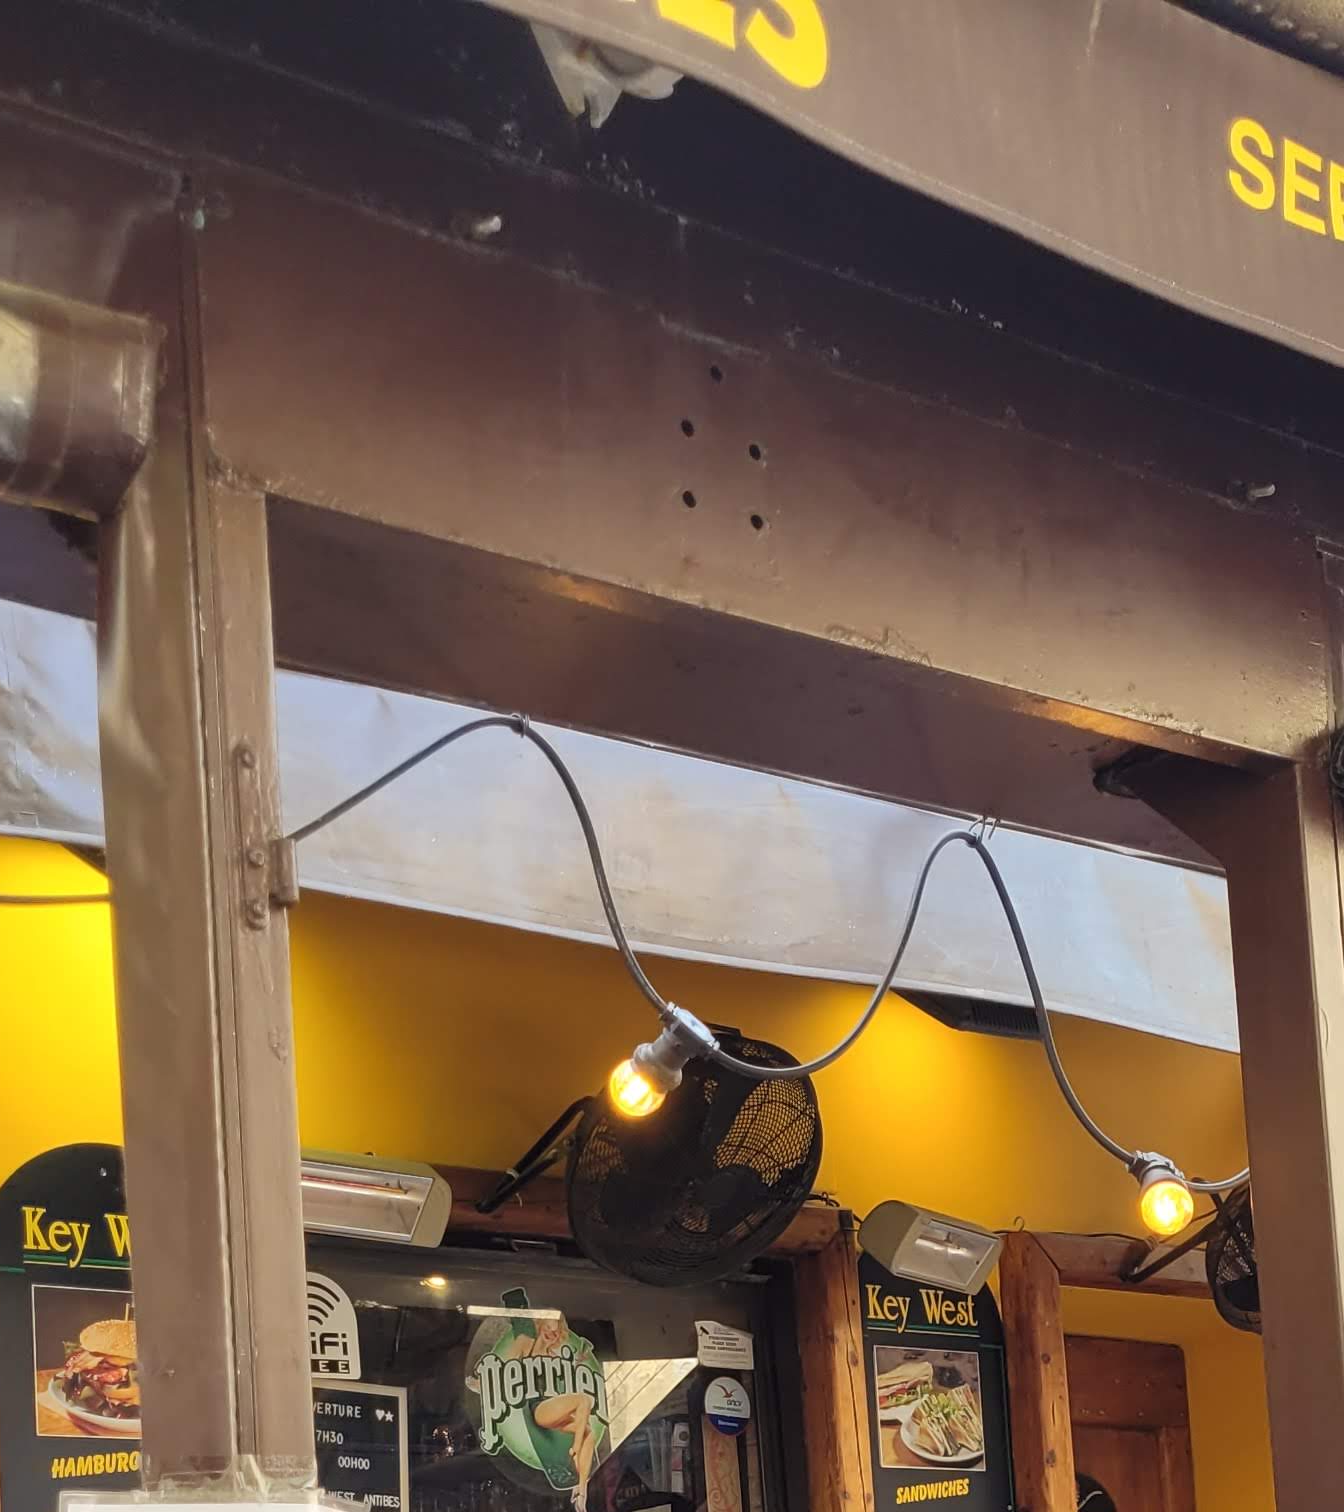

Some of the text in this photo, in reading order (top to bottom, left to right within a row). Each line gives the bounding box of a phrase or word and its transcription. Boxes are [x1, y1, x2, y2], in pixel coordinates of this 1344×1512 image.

[22, 1206, 91, 1269] Key
[865, 1284, 978, 1334] Key West
[363, 1492, 401, 1508] ANTIBES
[896, 1478, 970, 1505] SANDWICHES
